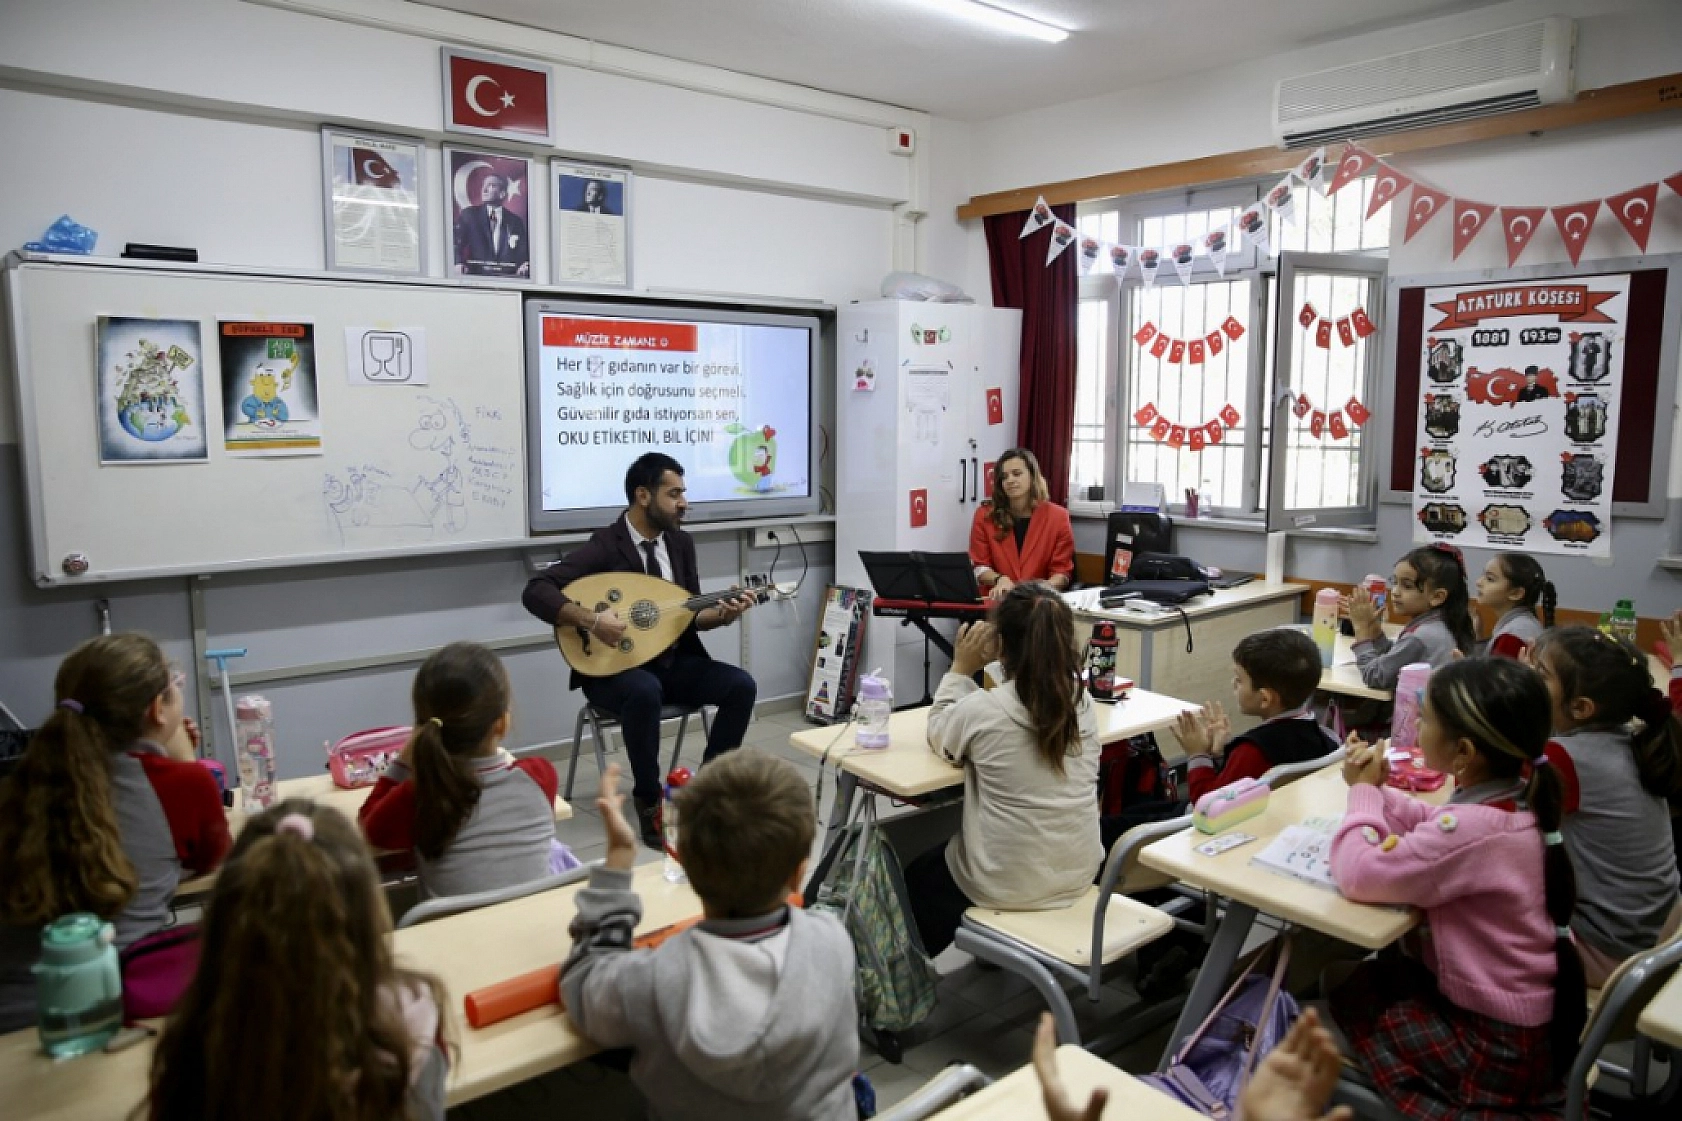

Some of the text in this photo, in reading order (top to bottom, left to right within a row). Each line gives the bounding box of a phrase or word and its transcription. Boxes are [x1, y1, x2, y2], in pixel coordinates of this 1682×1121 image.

[1474, 331, 1508, 345] 1881
[556, 356, 583, 372] Her
[608, 358, 656, 376] gıdanın
[660, 362, 680, 374] var
[683, 360, 700, 374] bir
[556, 381, 598, 400] Sağlık
[601, 381, 625, 400] için
[627, 382, 696, 400] doğrusunu
[557, 405, 740, 424] Güvenilir gıda istiyorsan sen,
[558, 429, 589, 445] OKU
[593, 427, 661, 446] ETİKETİNİ,
[663, 427, 683, 444] BİL
